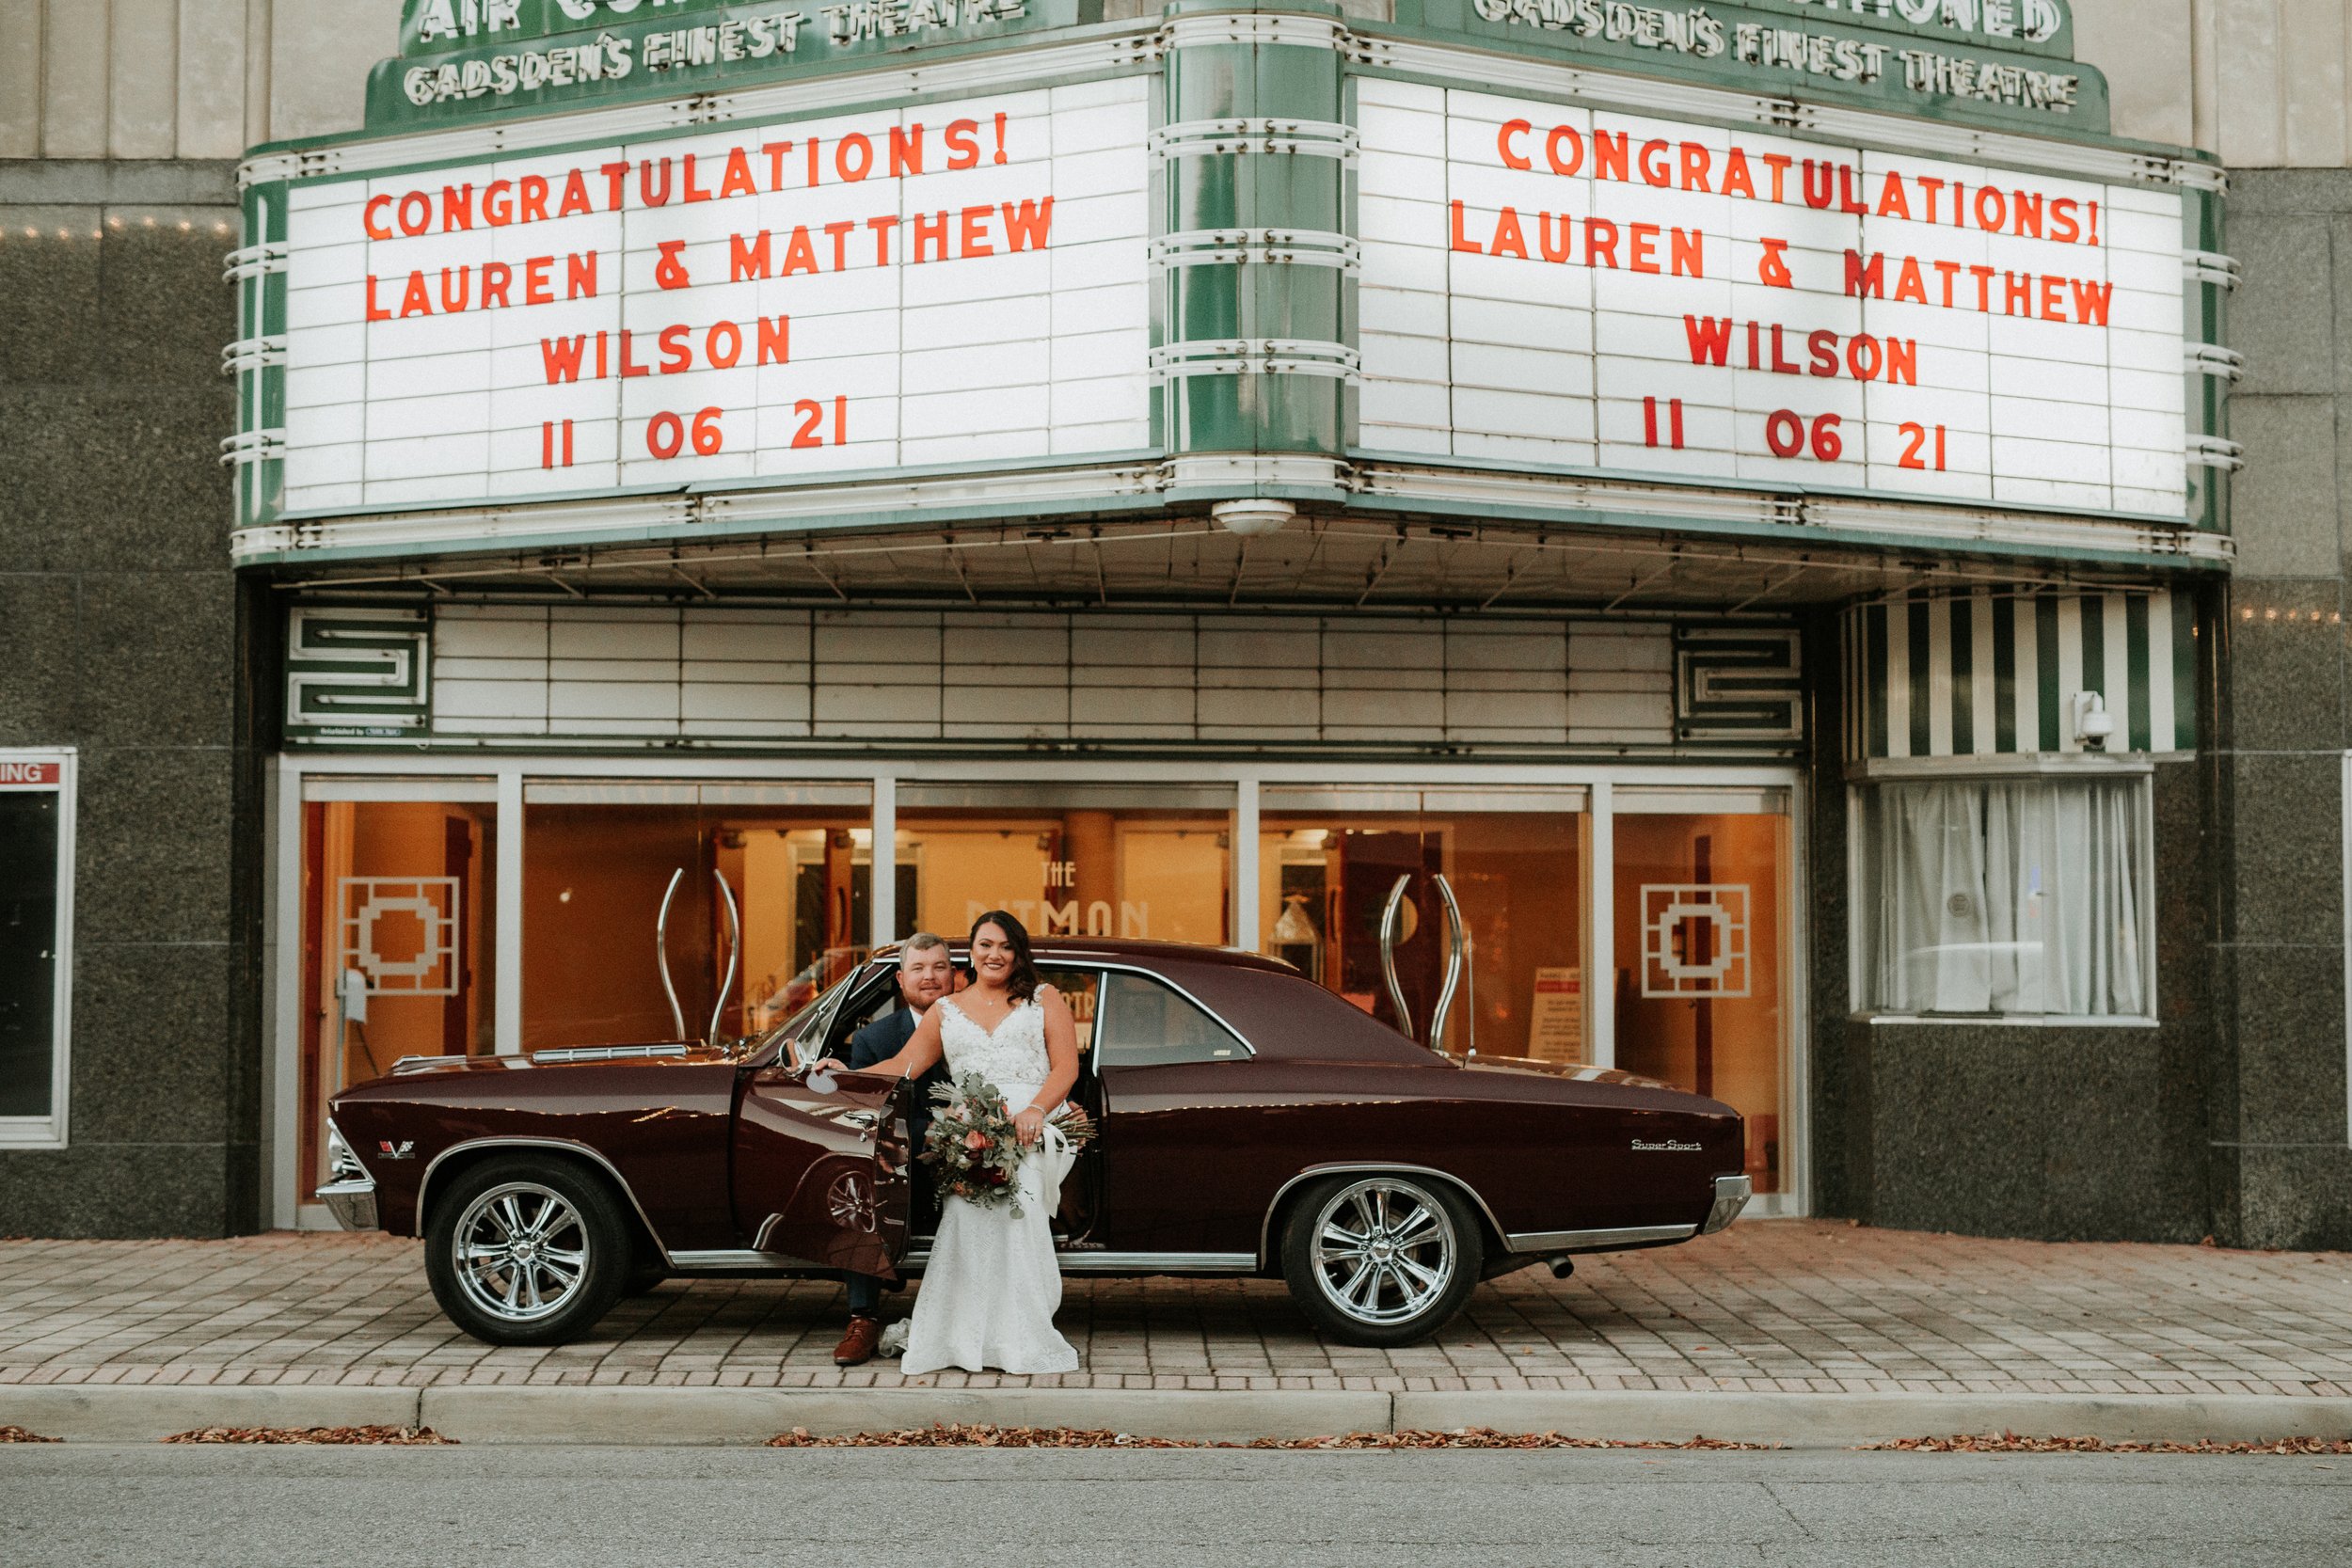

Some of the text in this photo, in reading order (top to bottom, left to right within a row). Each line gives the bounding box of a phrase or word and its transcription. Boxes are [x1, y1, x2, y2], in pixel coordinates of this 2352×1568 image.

[404, 32, 632, 105] GADSDEN'S
[643, 11, 804, 72] FINEST
[1734, 24, 1891, 83] FINEST
[1898, 49, 2078, 113] THEATRE
[363, 113, 1009, 241] CONGRATULATIONS!
[1498, 119, 2100, 246] CONGRATULATIONS!
[366, 196, 1055, 322] LAUREN & MATTHEW
[1452, 199, 2114, 327] LAUREN & MATTHEW
[541, 315, 789, 386] WILSON
[1684, 314, 1917, 387] WILSON
[542, 395, 848, 469] 11 06 21
[1644, 396, 1947, 472] 11 06 21
[1041, 862, 1076, 887] THE
[967, 899, 1149, 938] PTMAN
